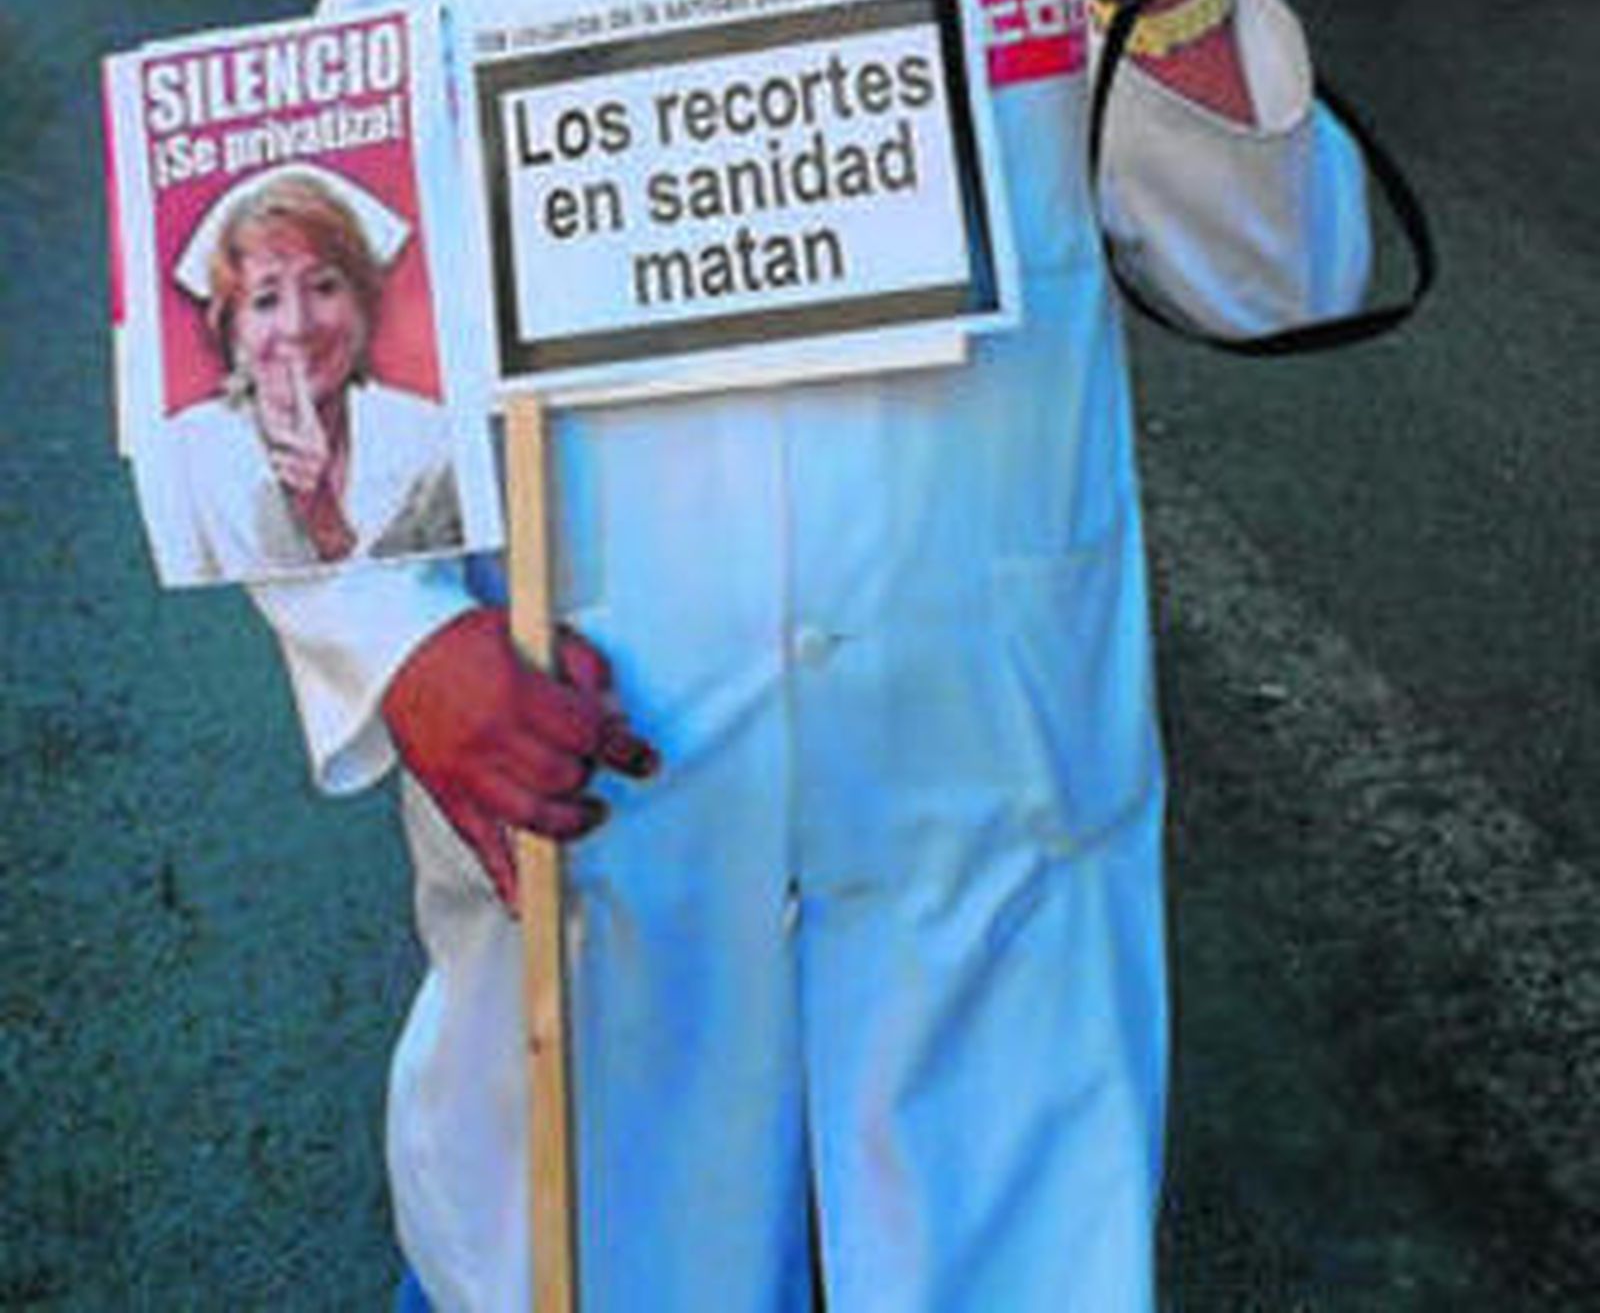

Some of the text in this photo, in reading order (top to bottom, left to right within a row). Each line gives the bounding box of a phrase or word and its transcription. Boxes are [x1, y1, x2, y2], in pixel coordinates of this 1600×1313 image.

[149, 23, 401, 134] SILENCIO
[513, 53, 936, 167] Los recortes
[545, 118, 918, 239] en sanidad
[633, 226, 845, 306] matan
